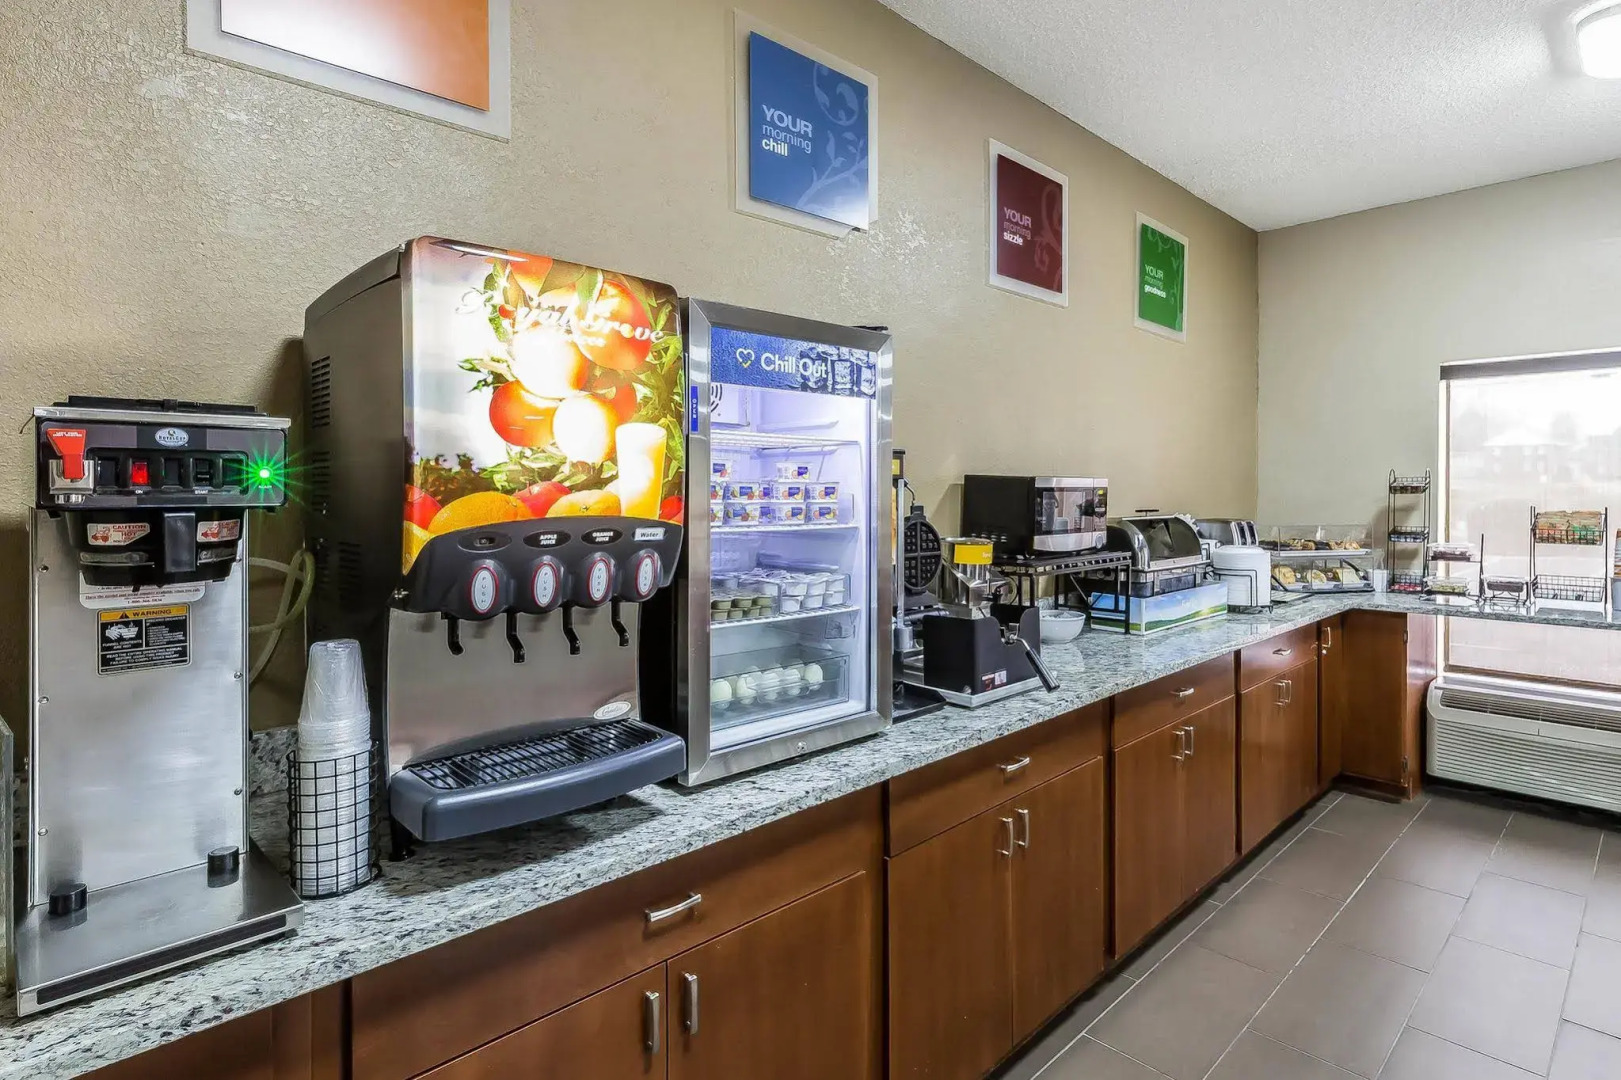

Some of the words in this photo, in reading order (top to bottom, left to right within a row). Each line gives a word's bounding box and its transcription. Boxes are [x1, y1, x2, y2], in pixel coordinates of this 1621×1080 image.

[762, 104, 812, 138] YOUR
[762, 124, 812, 154] morning
[762, 138, 788, 156] chill
[1004, 206, 1032, 228] YOUR
[1004, 221, 1031, 240] morning
[1004, 230, 1023, 246] sizzle
[1144, 264, 1164, 280] YOUR
[1144, 284, 1166, 298] goodness
[760, 352, 796, 374] Chill
[800, 358, 827, 378] Out
